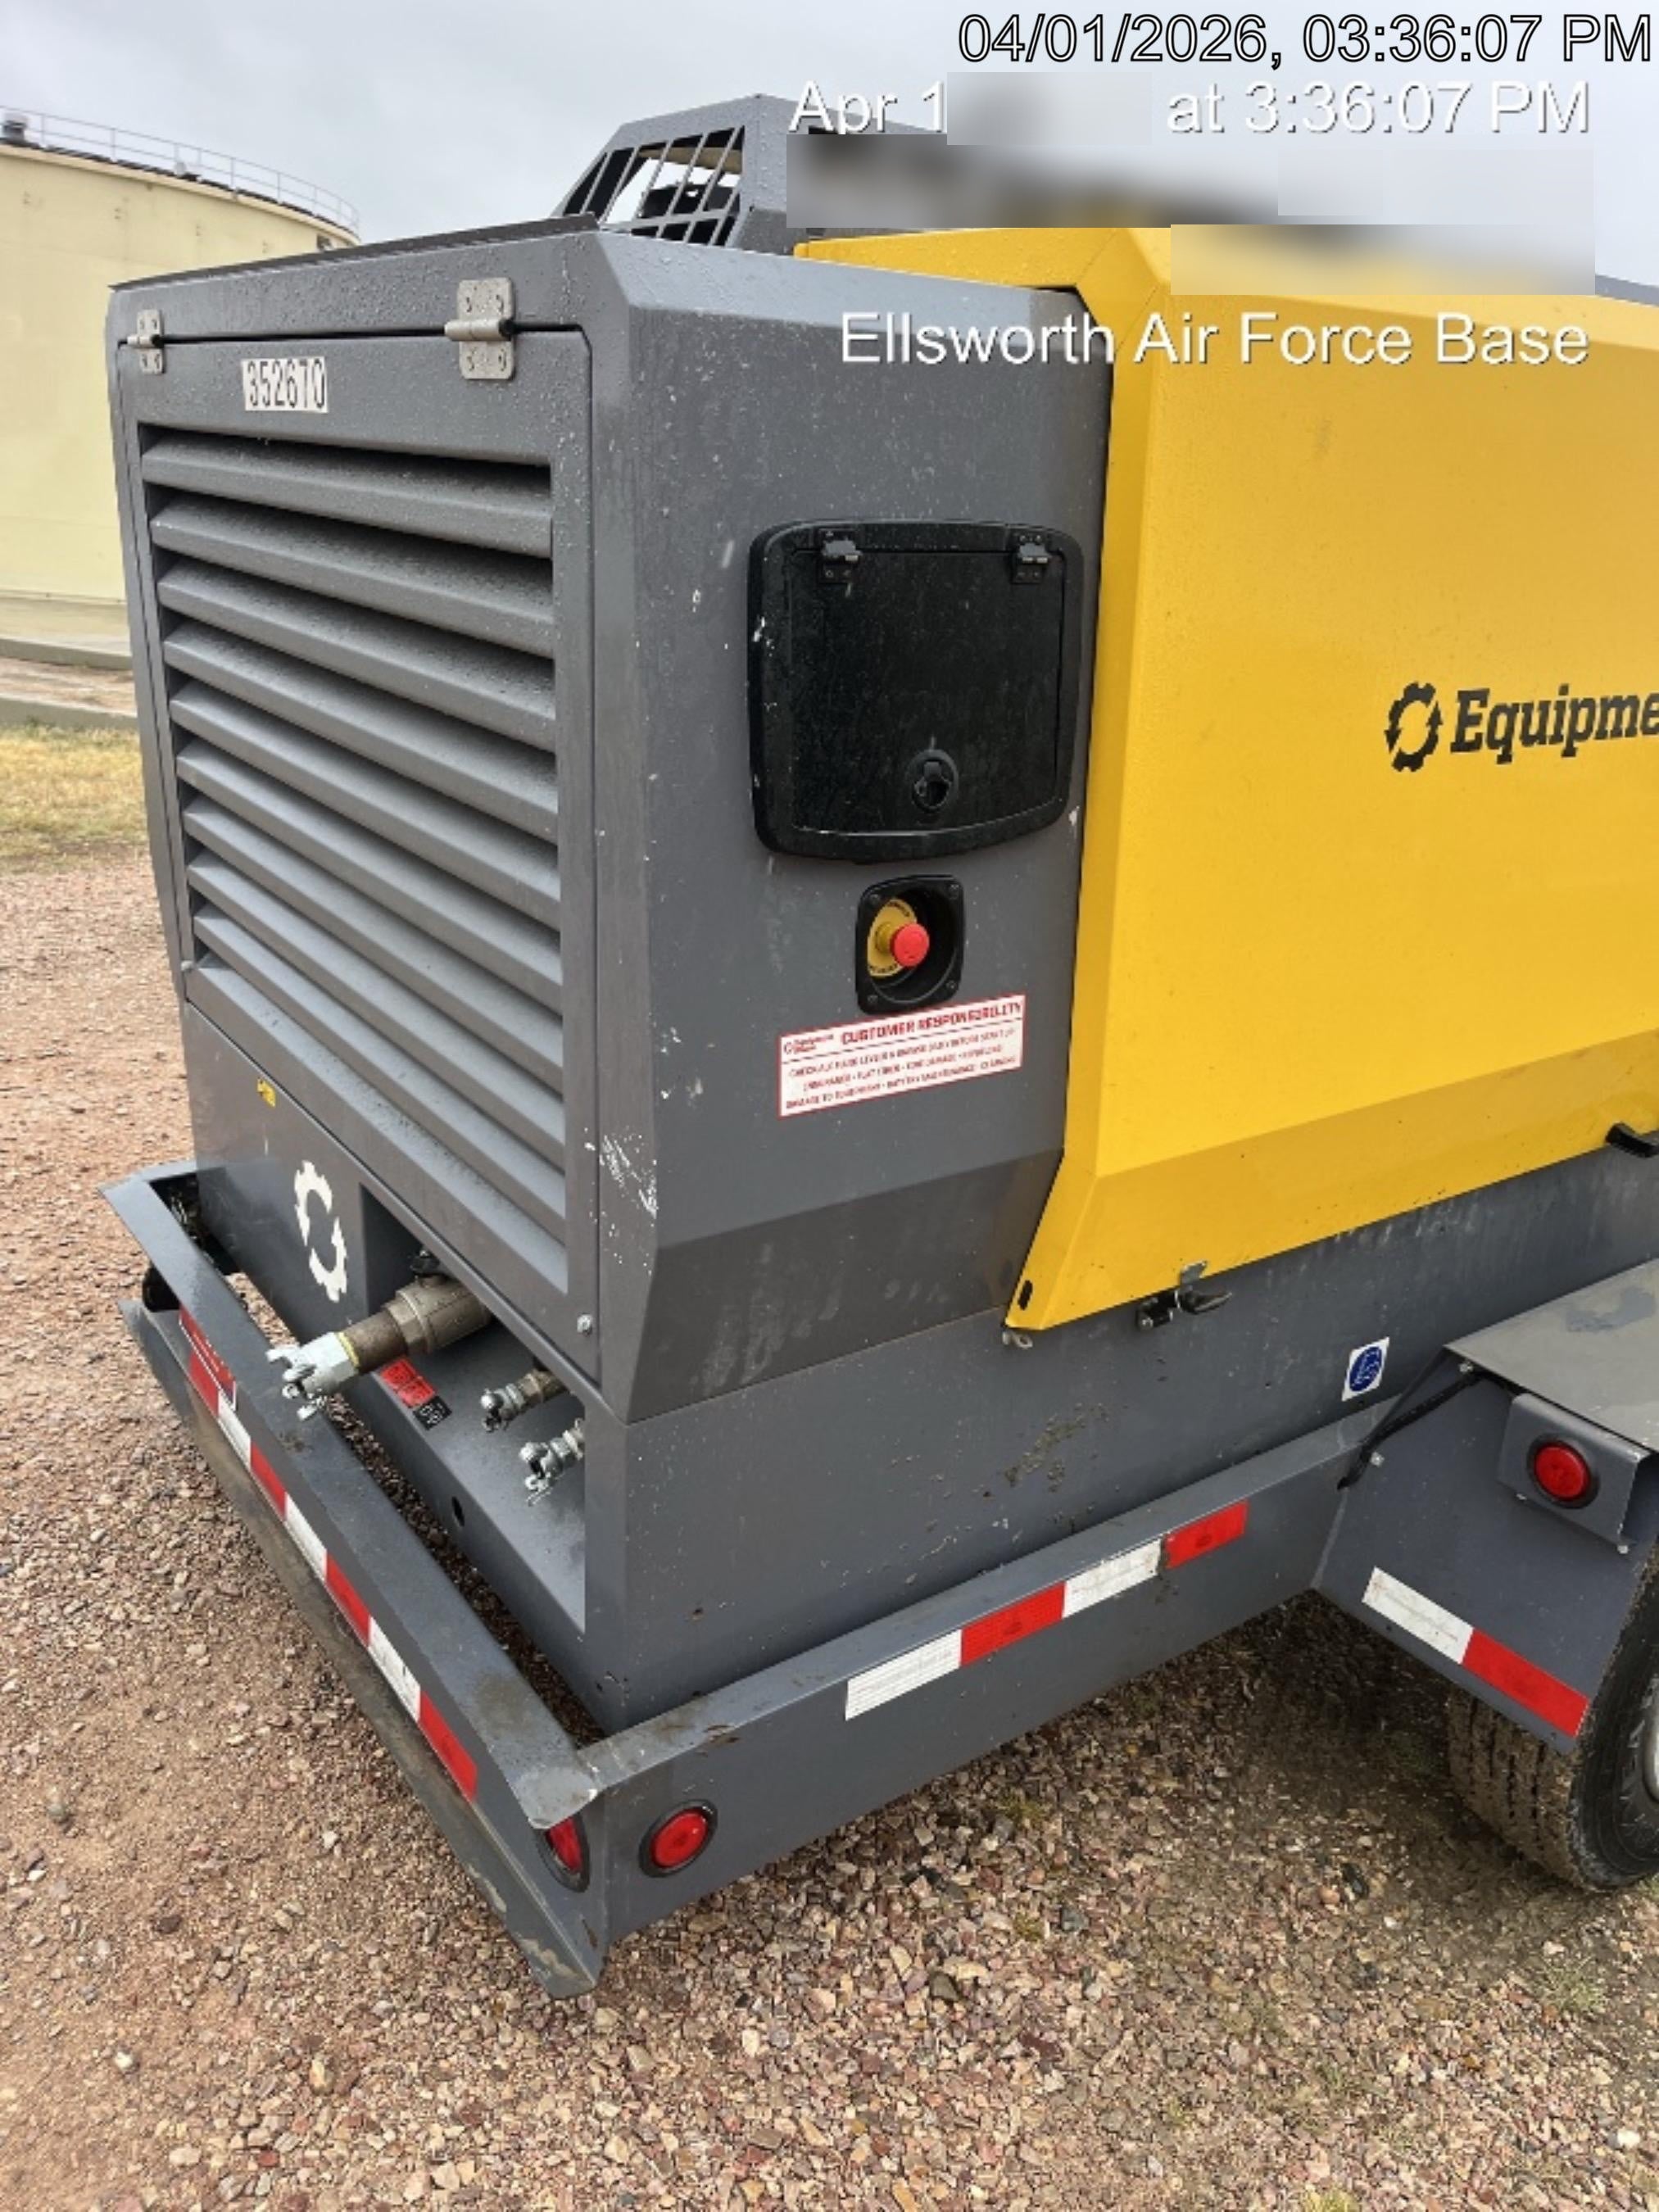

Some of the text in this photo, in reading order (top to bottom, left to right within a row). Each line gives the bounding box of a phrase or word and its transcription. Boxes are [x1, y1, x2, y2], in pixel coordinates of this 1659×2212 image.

[247, 358, 324, 408] 352670
[842, 1002, 1021, 1045] CUSTOMER RESPONSIBILITY
